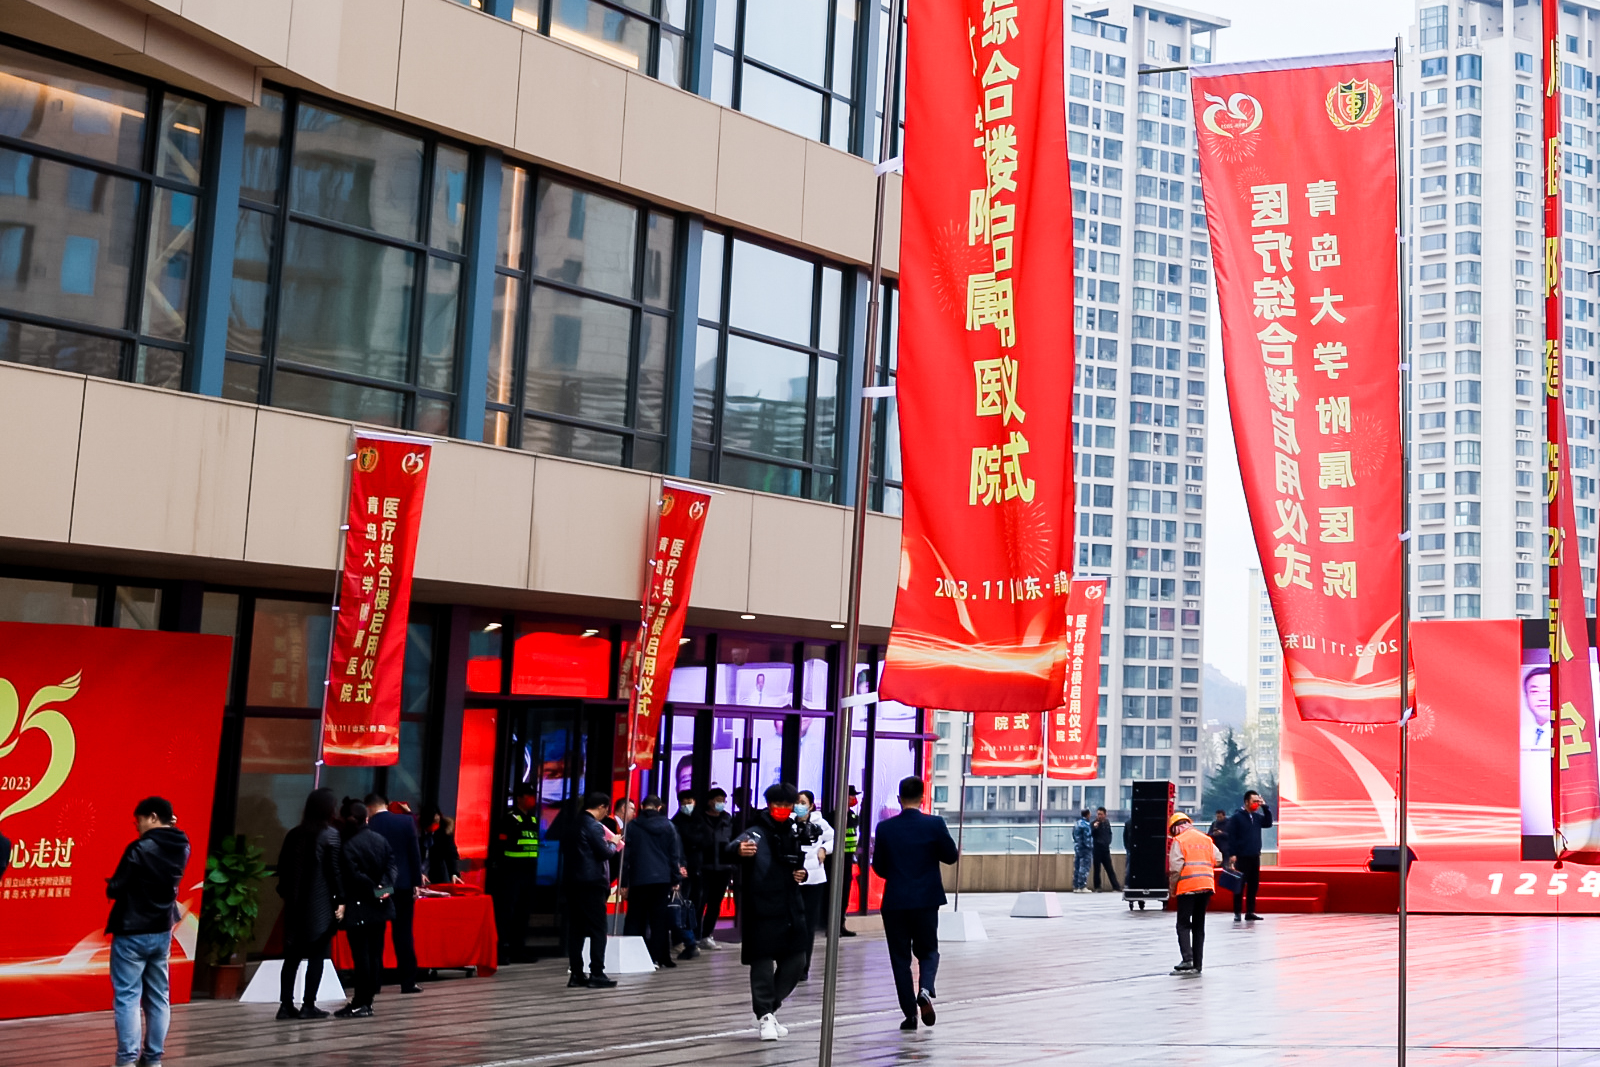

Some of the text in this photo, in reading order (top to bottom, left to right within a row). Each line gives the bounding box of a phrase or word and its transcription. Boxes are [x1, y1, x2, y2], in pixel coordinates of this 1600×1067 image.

[355, 497, 400, 704] 医疗综合楼启用仪式
